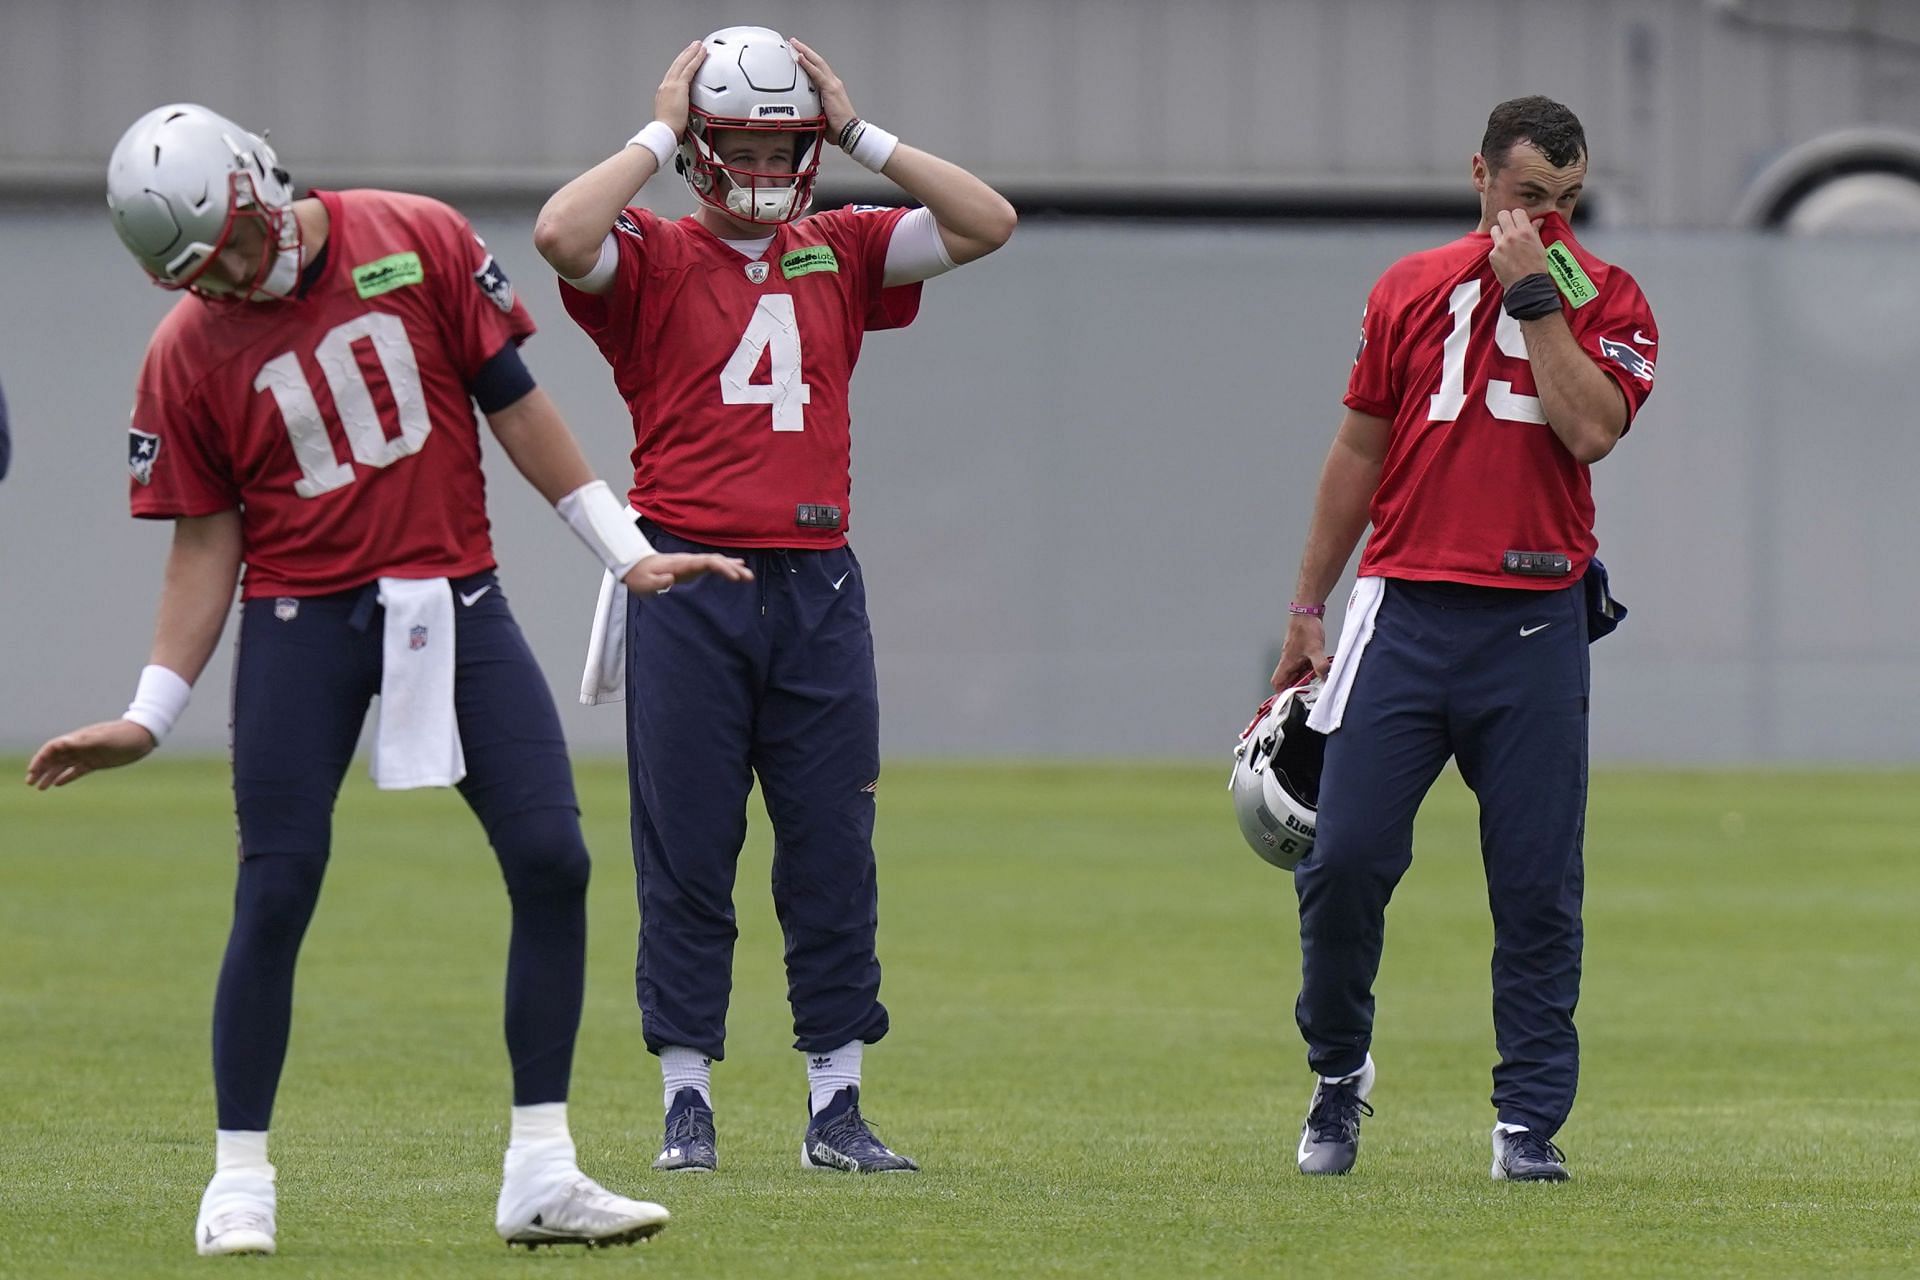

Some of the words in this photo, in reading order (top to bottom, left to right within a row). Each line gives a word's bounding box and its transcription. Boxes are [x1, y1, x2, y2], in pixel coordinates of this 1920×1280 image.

[759, 106, 795, 117] PATRIOTS
[253, 311, 432, 499] 10
[720, 293, 811, 432] 4
